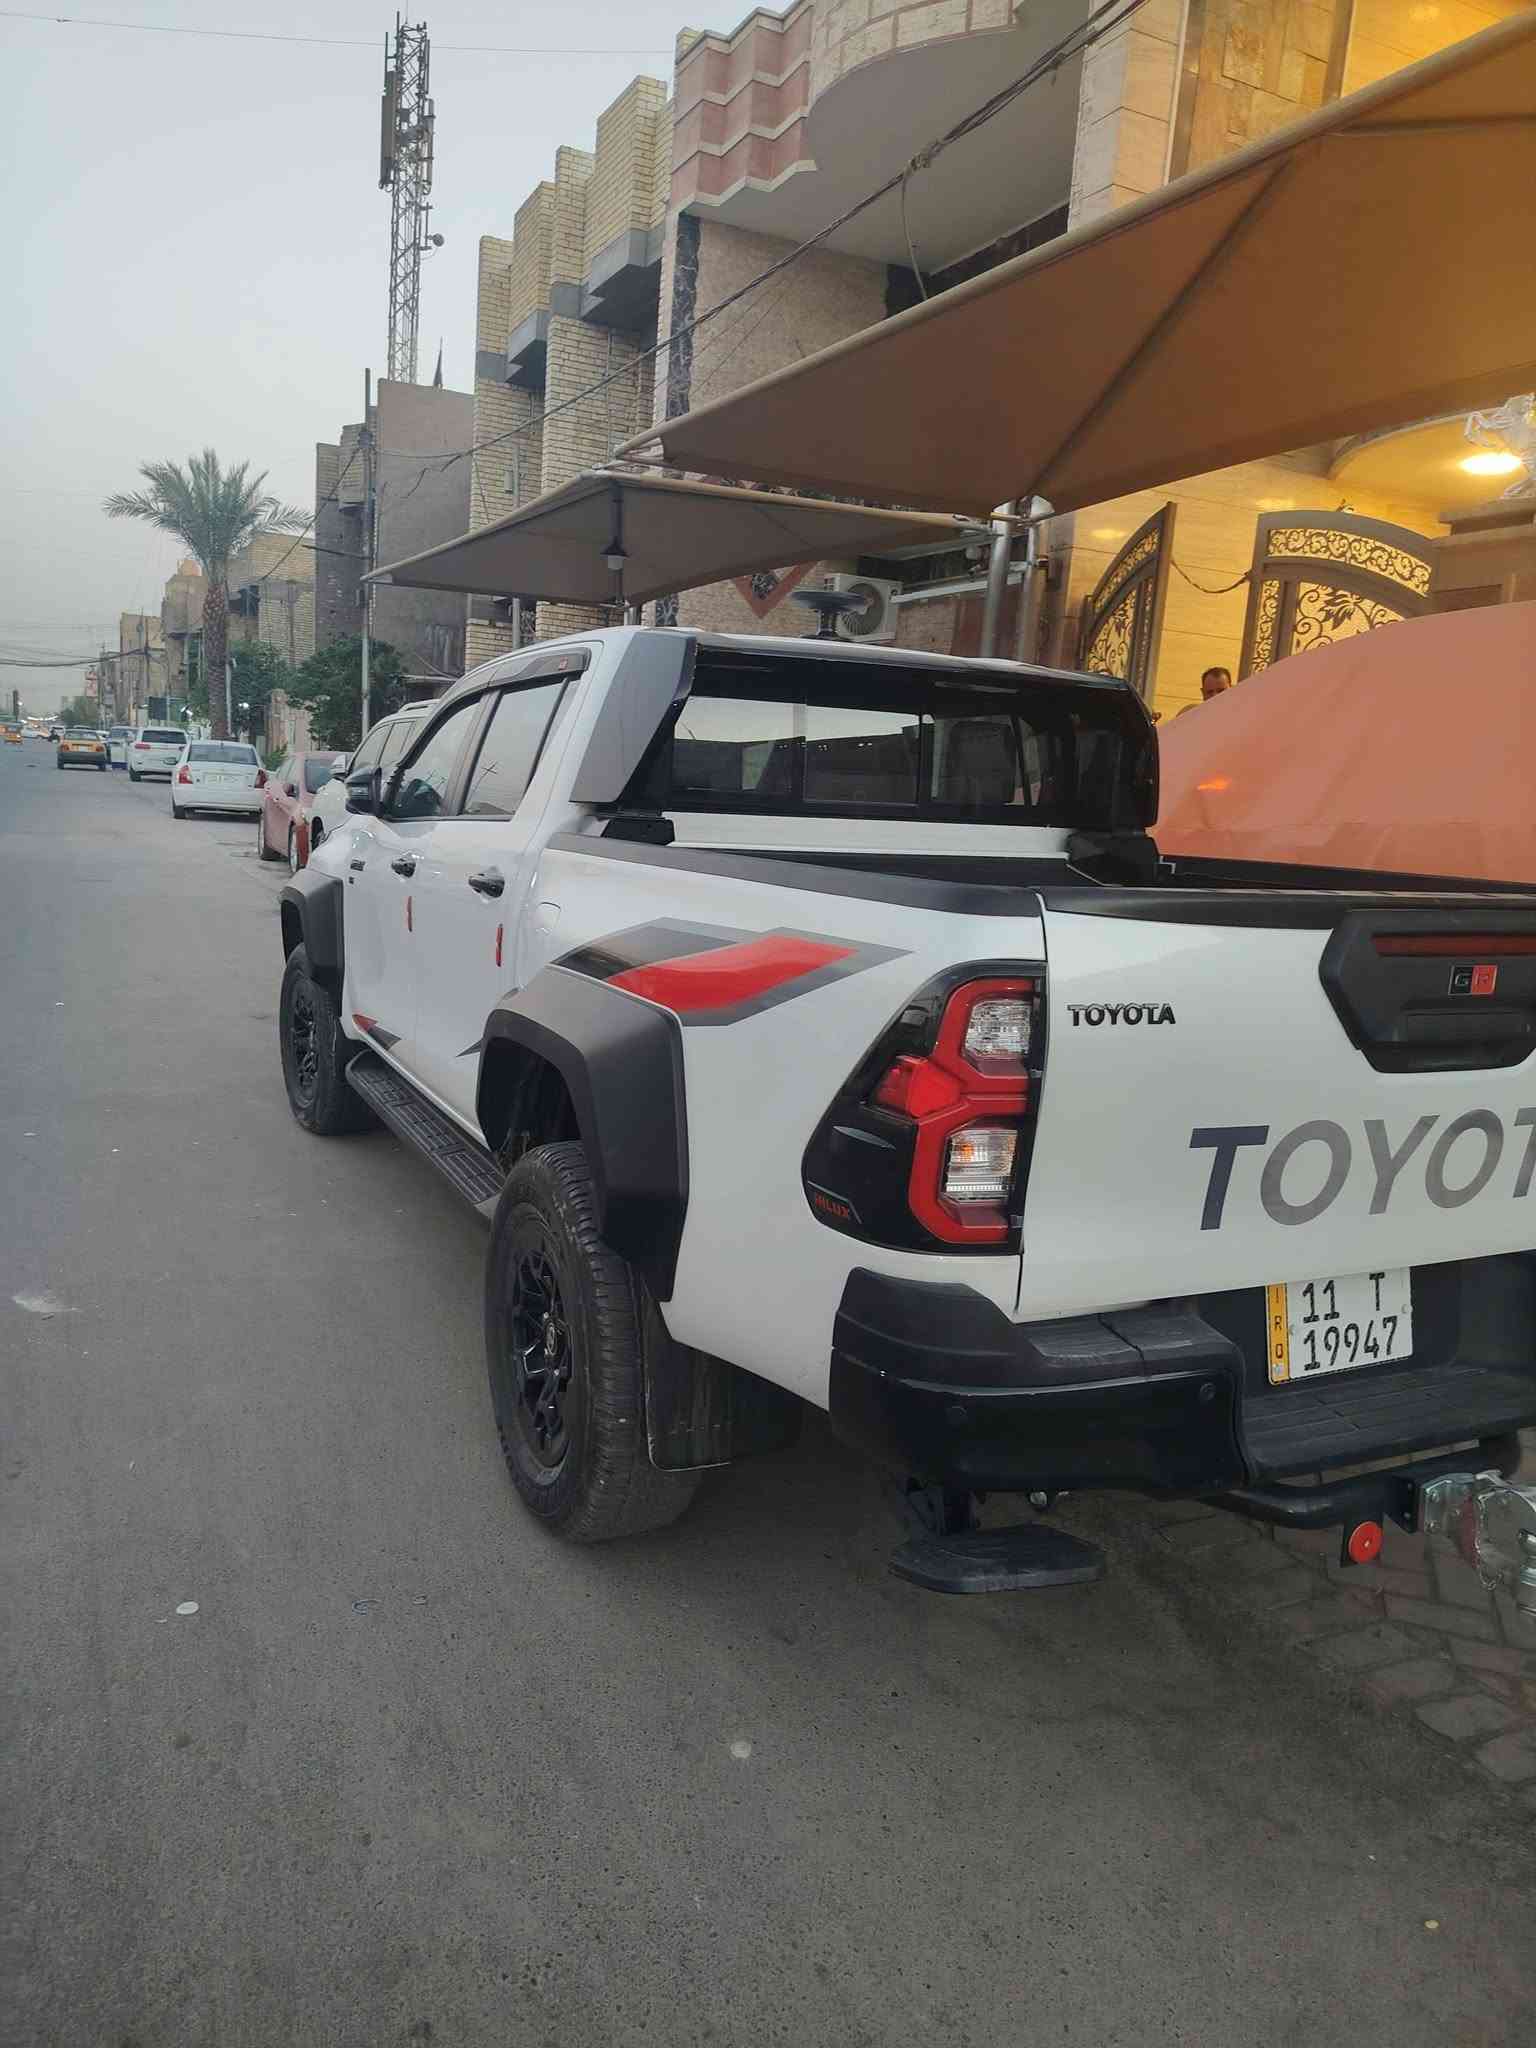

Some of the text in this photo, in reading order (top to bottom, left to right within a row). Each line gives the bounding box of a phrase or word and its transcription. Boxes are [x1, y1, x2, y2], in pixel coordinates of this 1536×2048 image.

[1066, 1002, 1177, 1027] TOYOTA
[1302, 1271, 1386, 1324] 11 T
[1303, 1315, 1399, 1372] 19947
